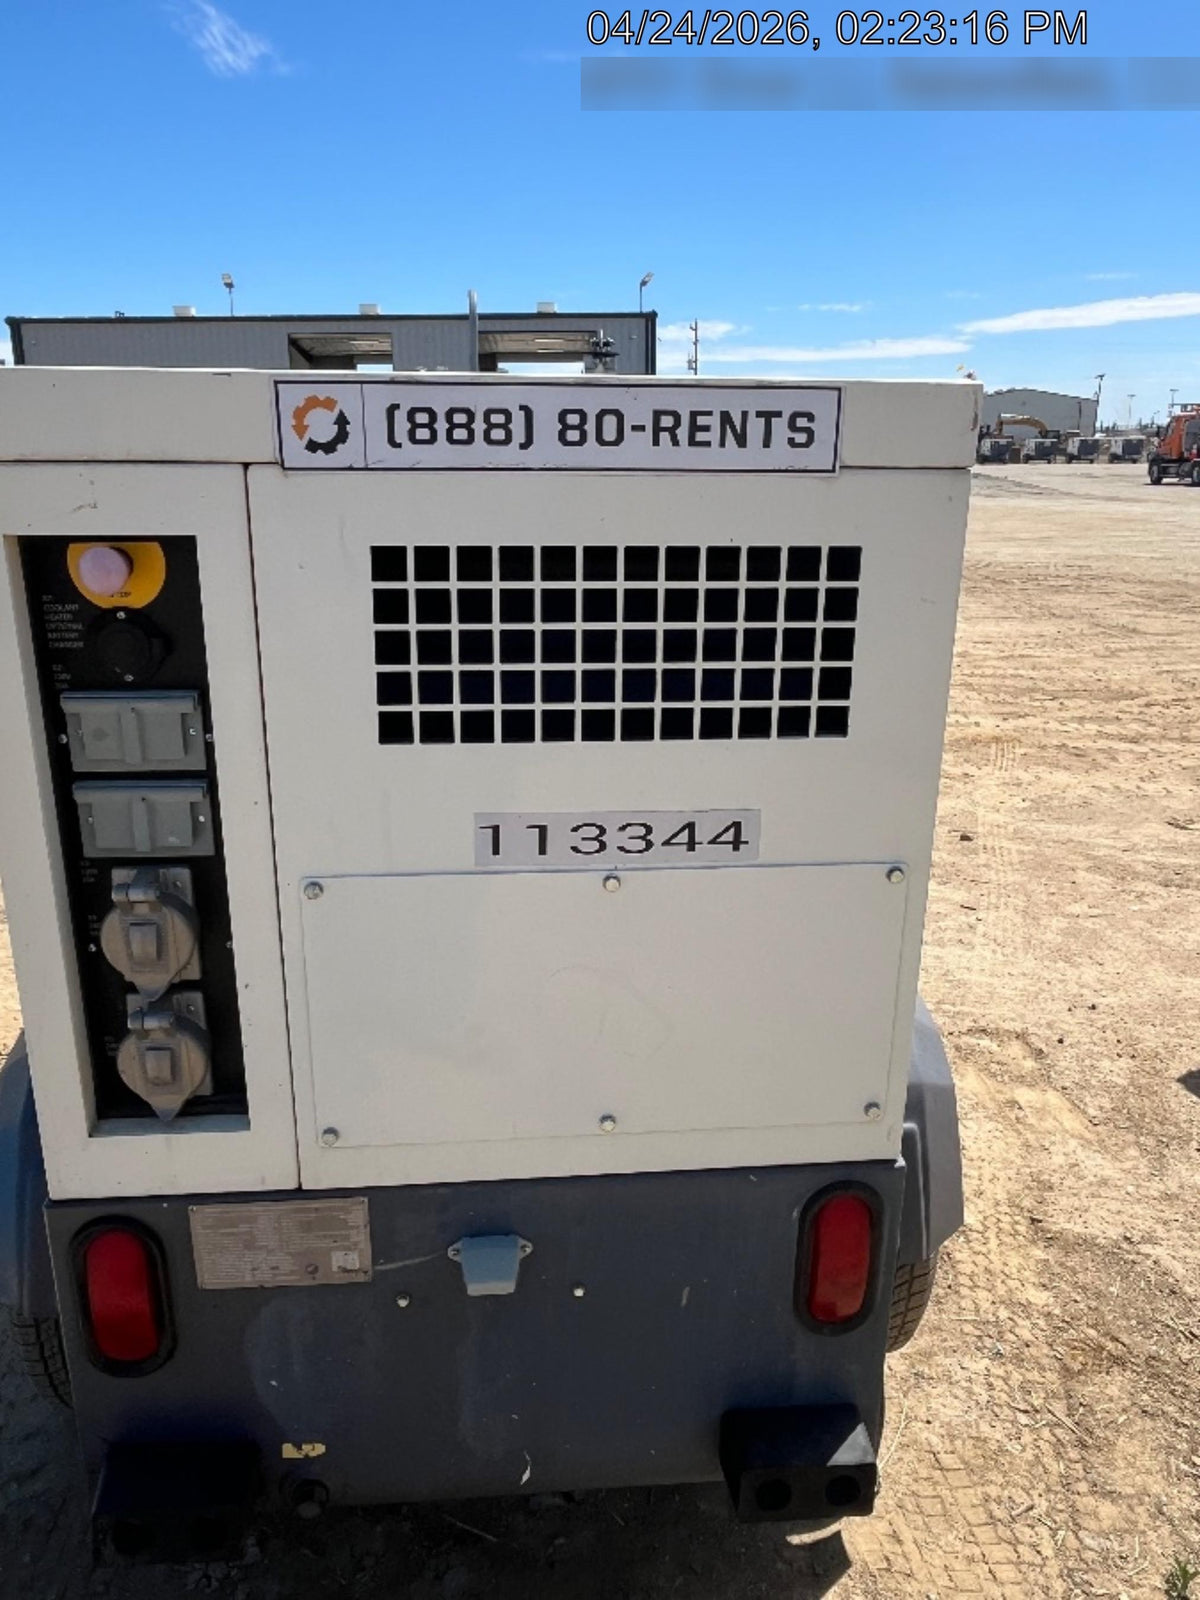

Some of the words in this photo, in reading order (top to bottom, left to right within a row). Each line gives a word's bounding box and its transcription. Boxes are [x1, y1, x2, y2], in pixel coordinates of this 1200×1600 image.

[385, 402, 534, 451] (888)
[557, 407, 816, 449] 80-RENTS
[479, 820, 750, 856] 113344
